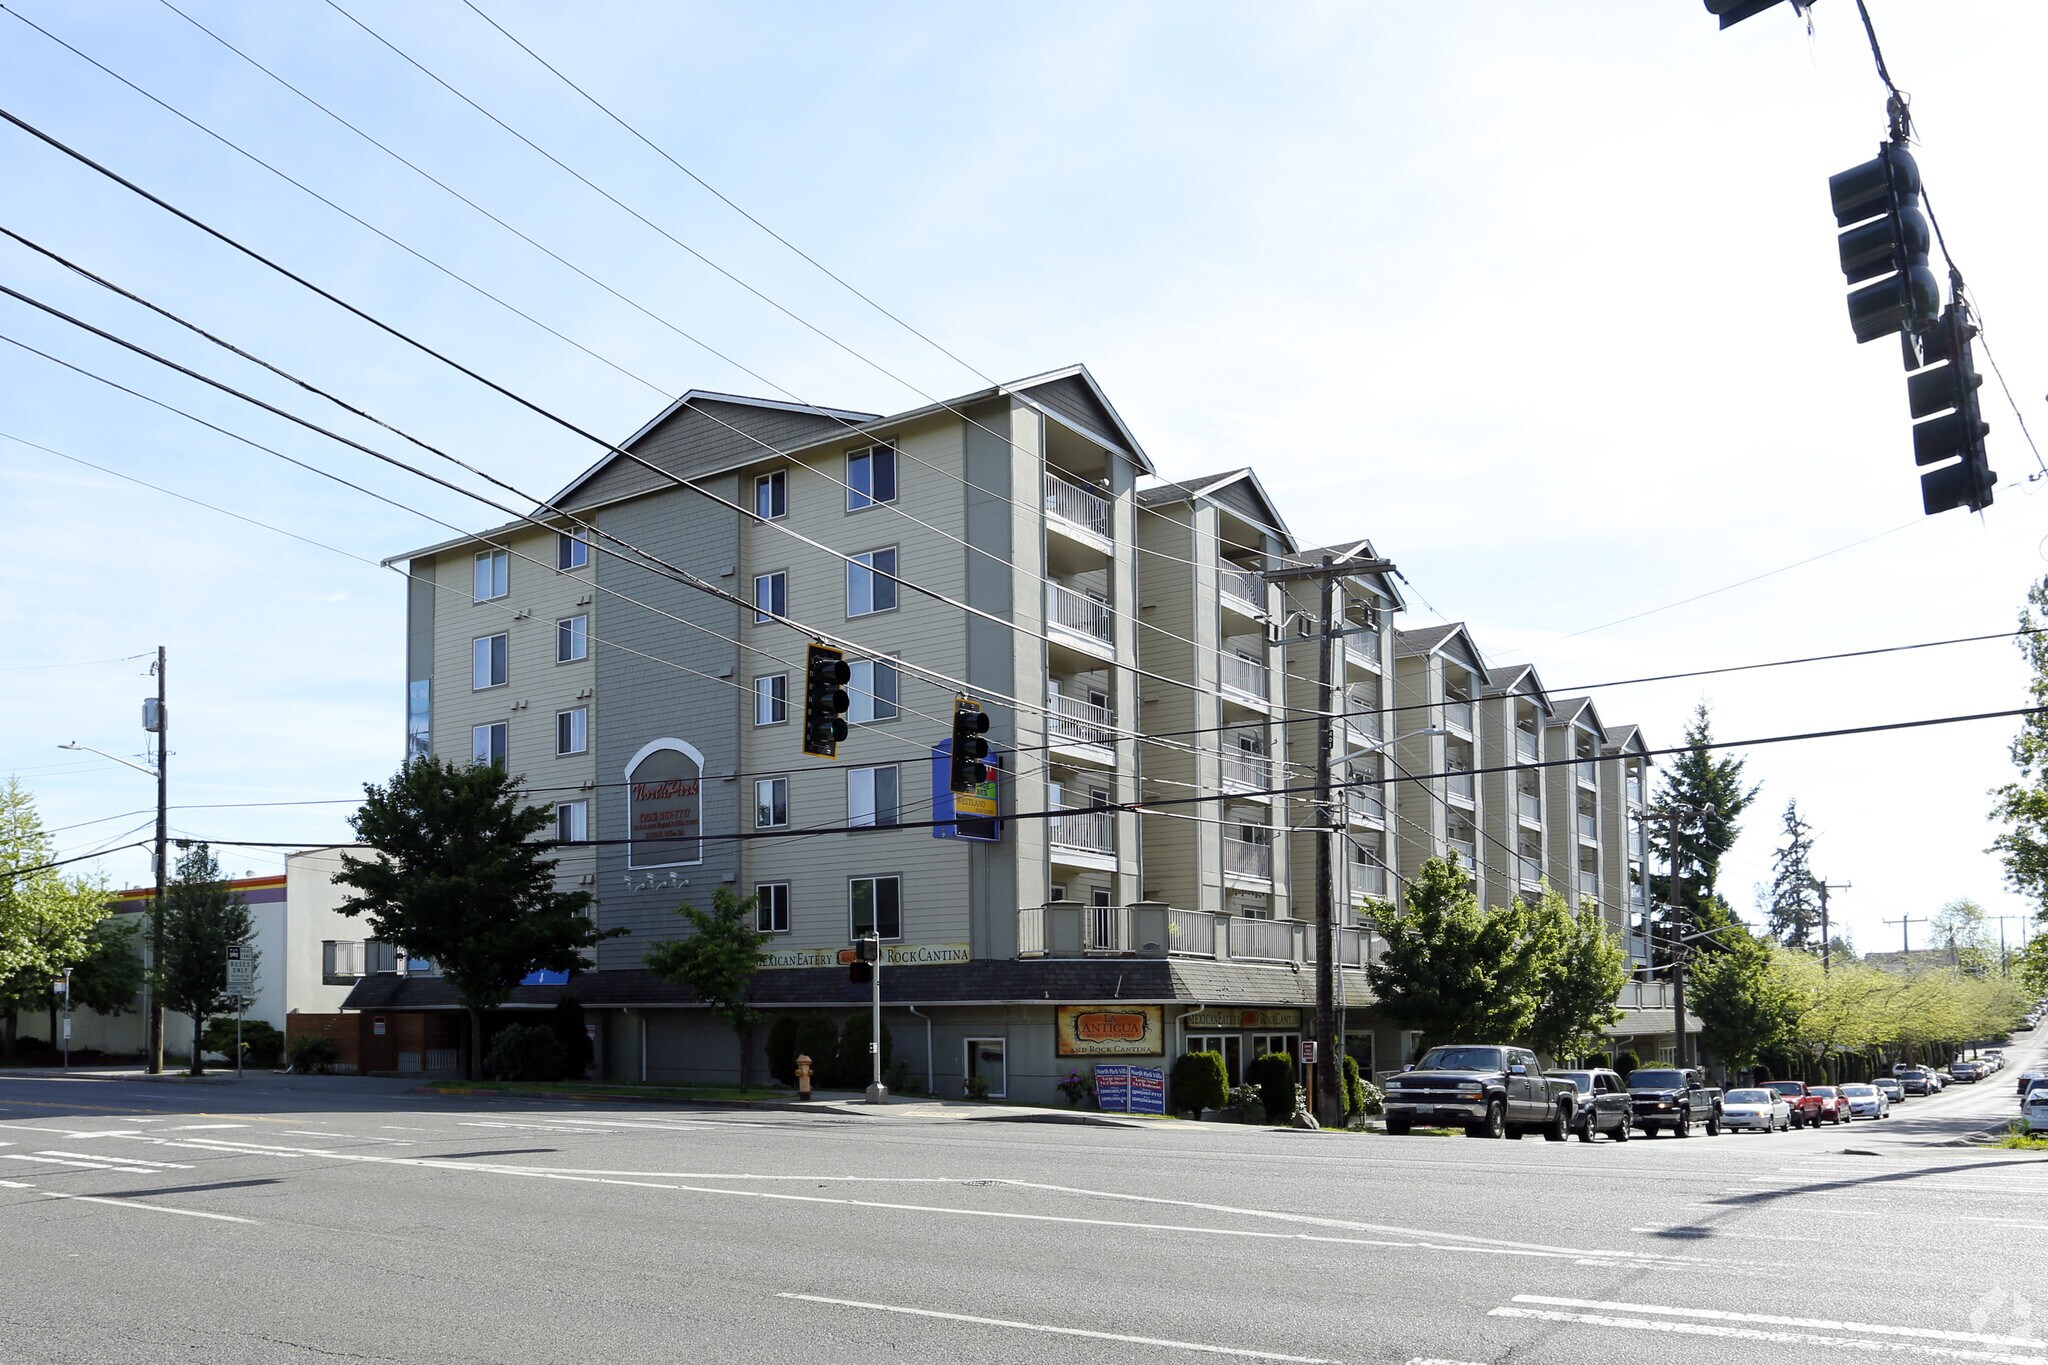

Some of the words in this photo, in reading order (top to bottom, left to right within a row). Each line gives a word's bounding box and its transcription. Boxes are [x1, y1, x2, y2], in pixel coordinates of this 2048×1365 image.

[887, 949, 917, 963] ROCK
[918, 948, 968, 962] CANTINA
[1103, 1014, 1116, 1023] LA
[1082, 1023, 1139, 1033] ANTIGUA
[1114, 1045, 1152, 1053] CANTINA
